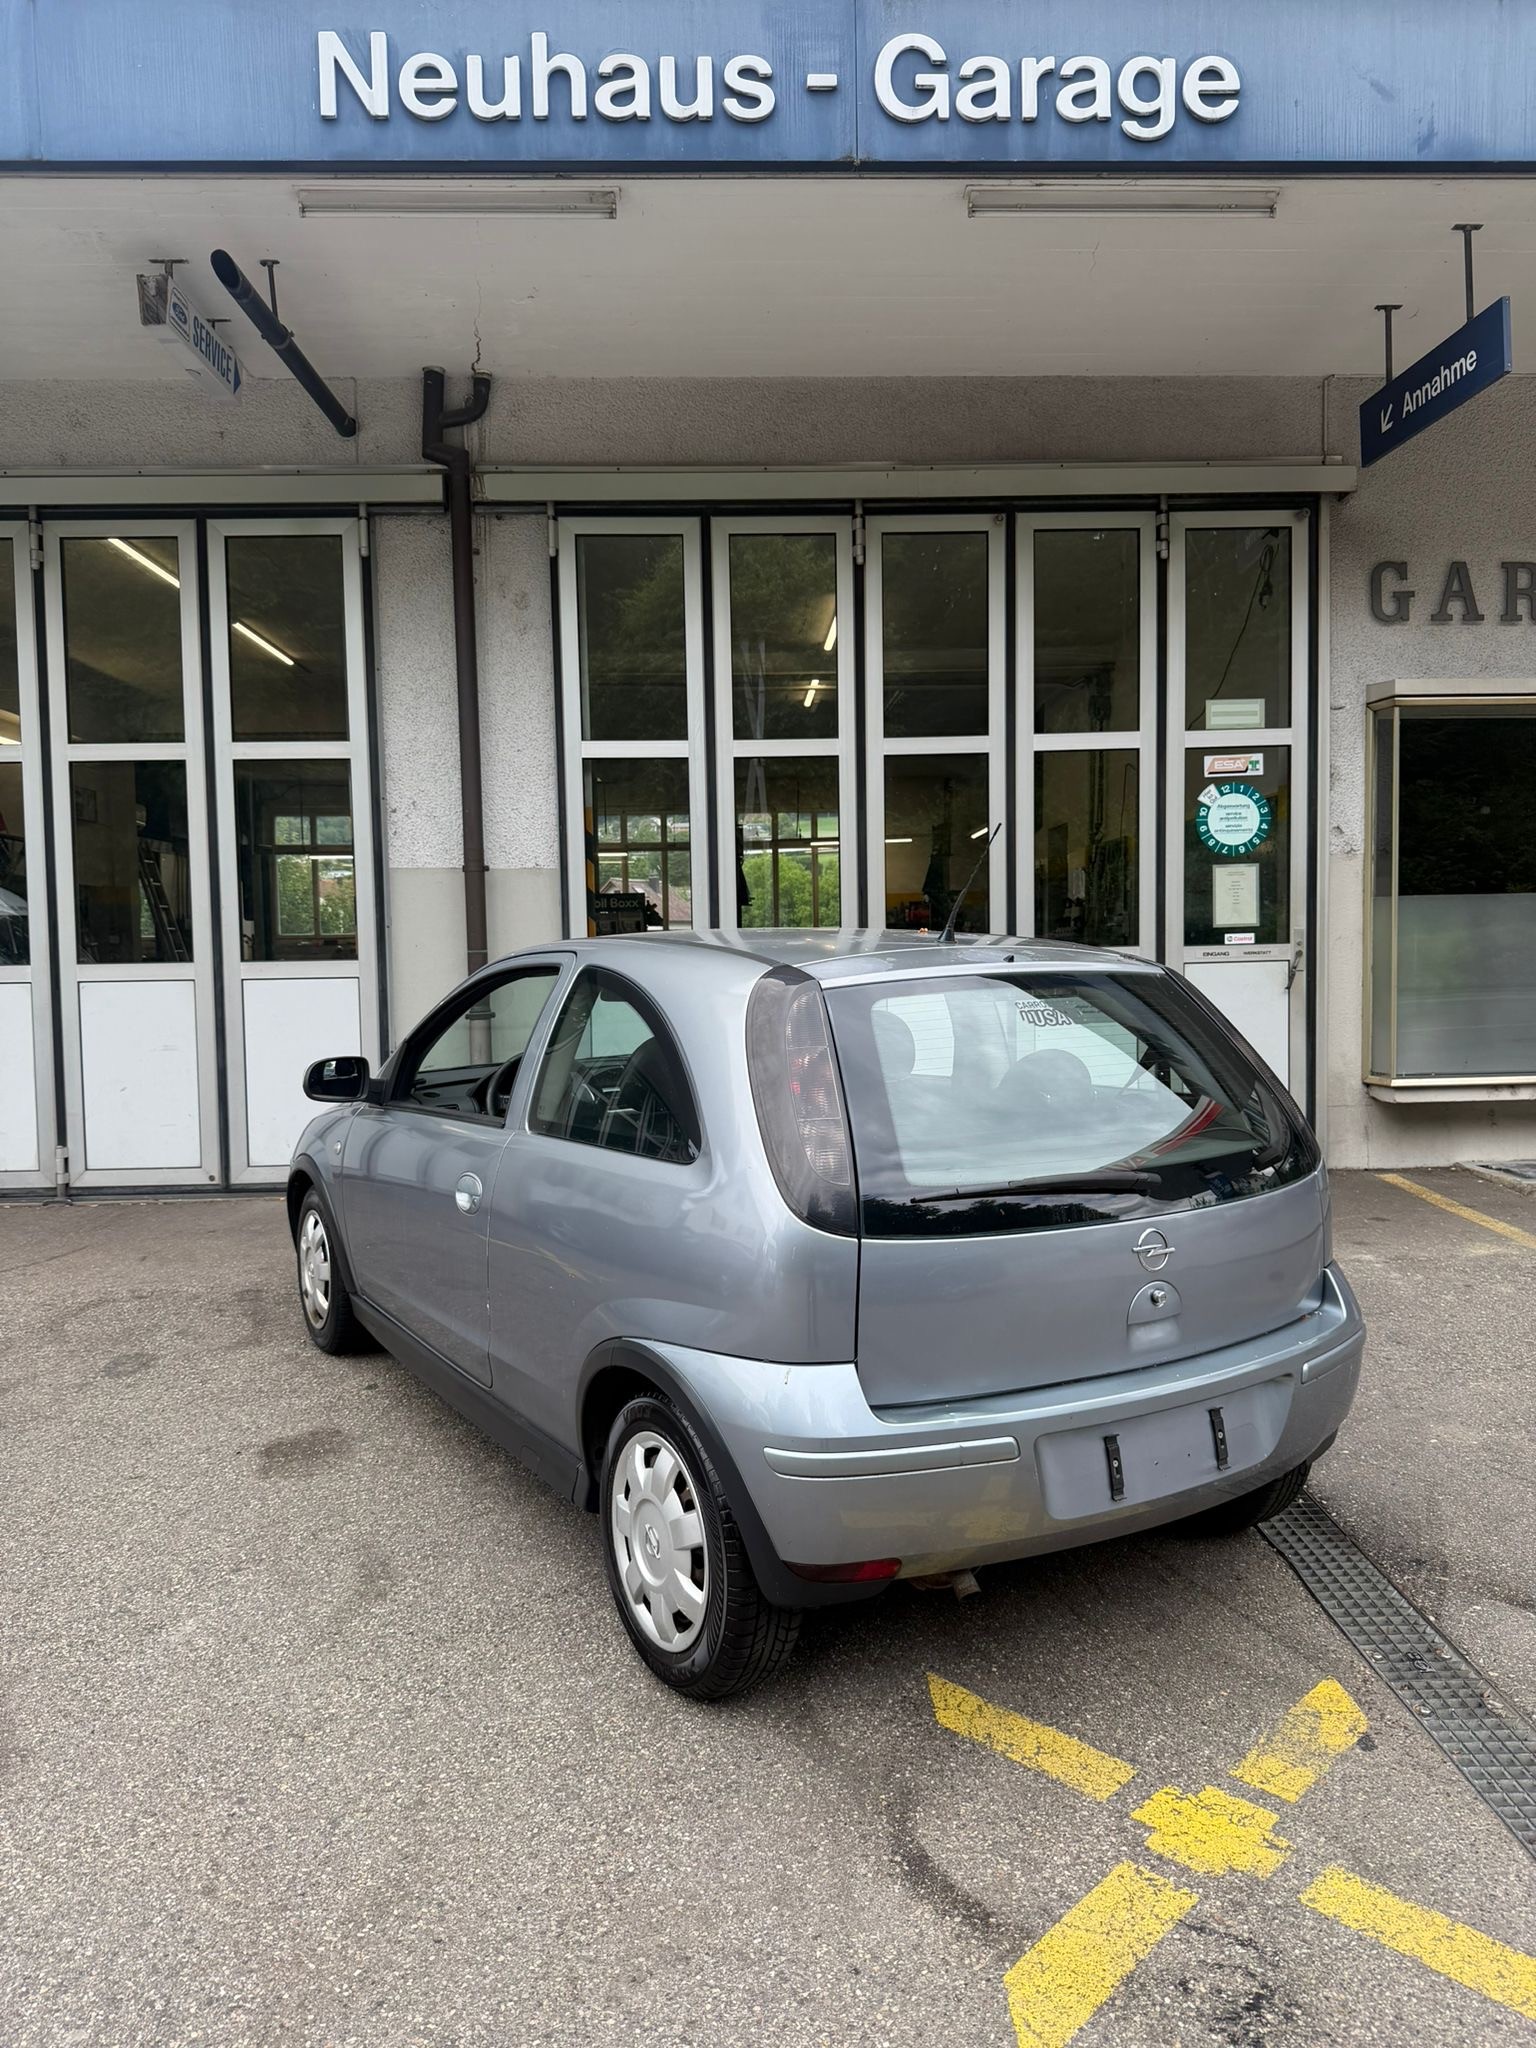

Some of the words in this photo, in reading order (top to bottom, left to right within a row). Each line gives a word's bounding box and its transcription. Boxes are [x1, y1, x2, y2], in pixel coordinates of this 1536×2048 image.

[317, 30, 776, 123] Neuhaus
[806, 72, 838, 91] -
[874, 31, 1241, 142] Garage
[193, 315, 233, 385] SERVICE
[1402, 349, 1478, 419] Annahme
[1370, 560, 1536, 623] GAR
[1221, 785, 1231, 793] 12
[1239, 785, 1244, 793] 1
[1260, 806, 1268, 814] 3
[610, 897, 639, 908] Boxx
